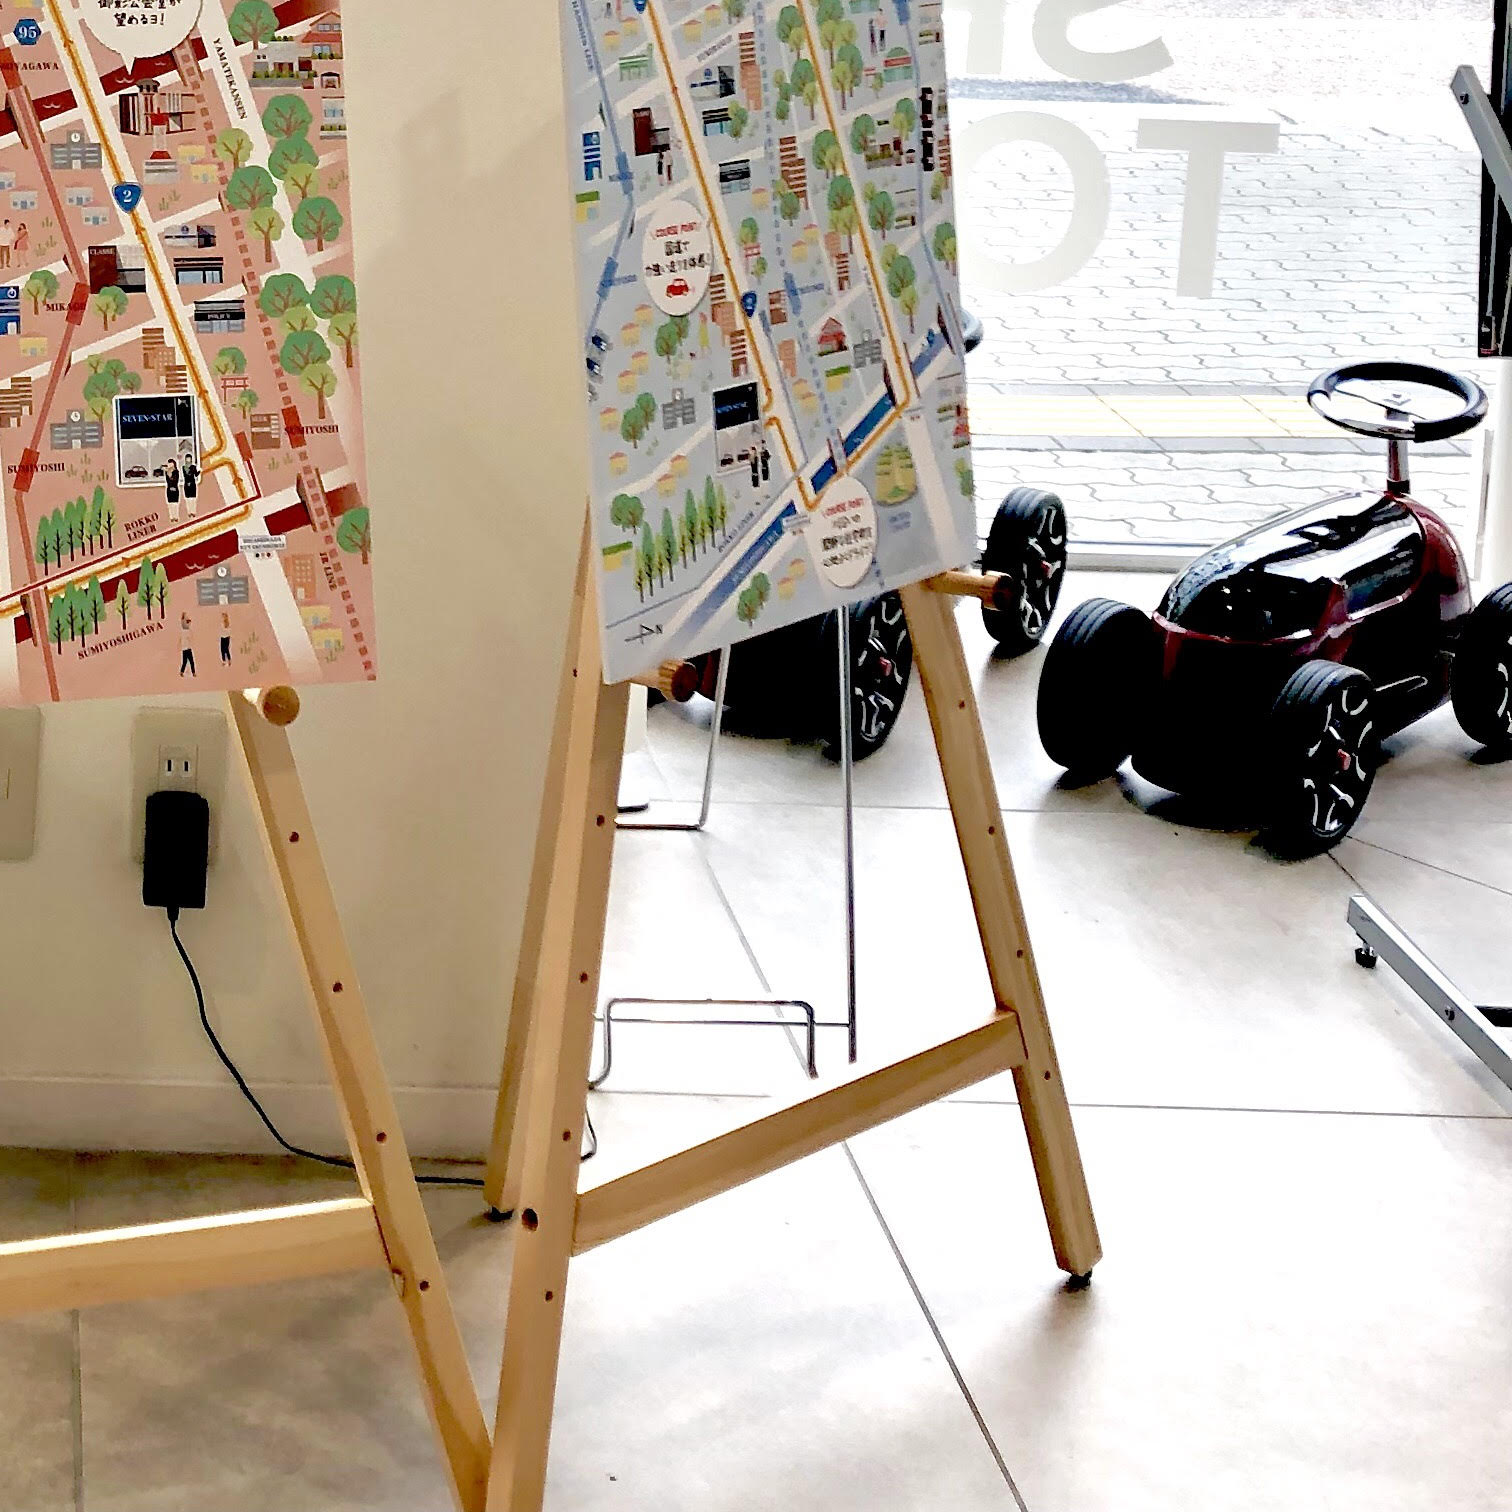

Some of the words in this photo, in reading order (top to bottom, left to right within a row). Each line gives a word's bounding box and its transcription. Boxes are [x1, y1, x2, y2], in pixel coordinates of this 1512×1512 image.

[18, 25, 38, 39] 95
[212, 38, 248, 120] YAMATEKANSEN
[122, 190, 133, 202] 2
[121, 412, 174, 423] SEVEN-STAR
[124, 512, 159, 531] ROKKO
[127, 524, 158, 542] LINER
[77, 621, 164, 660] SUMIYOSHIGAWA
